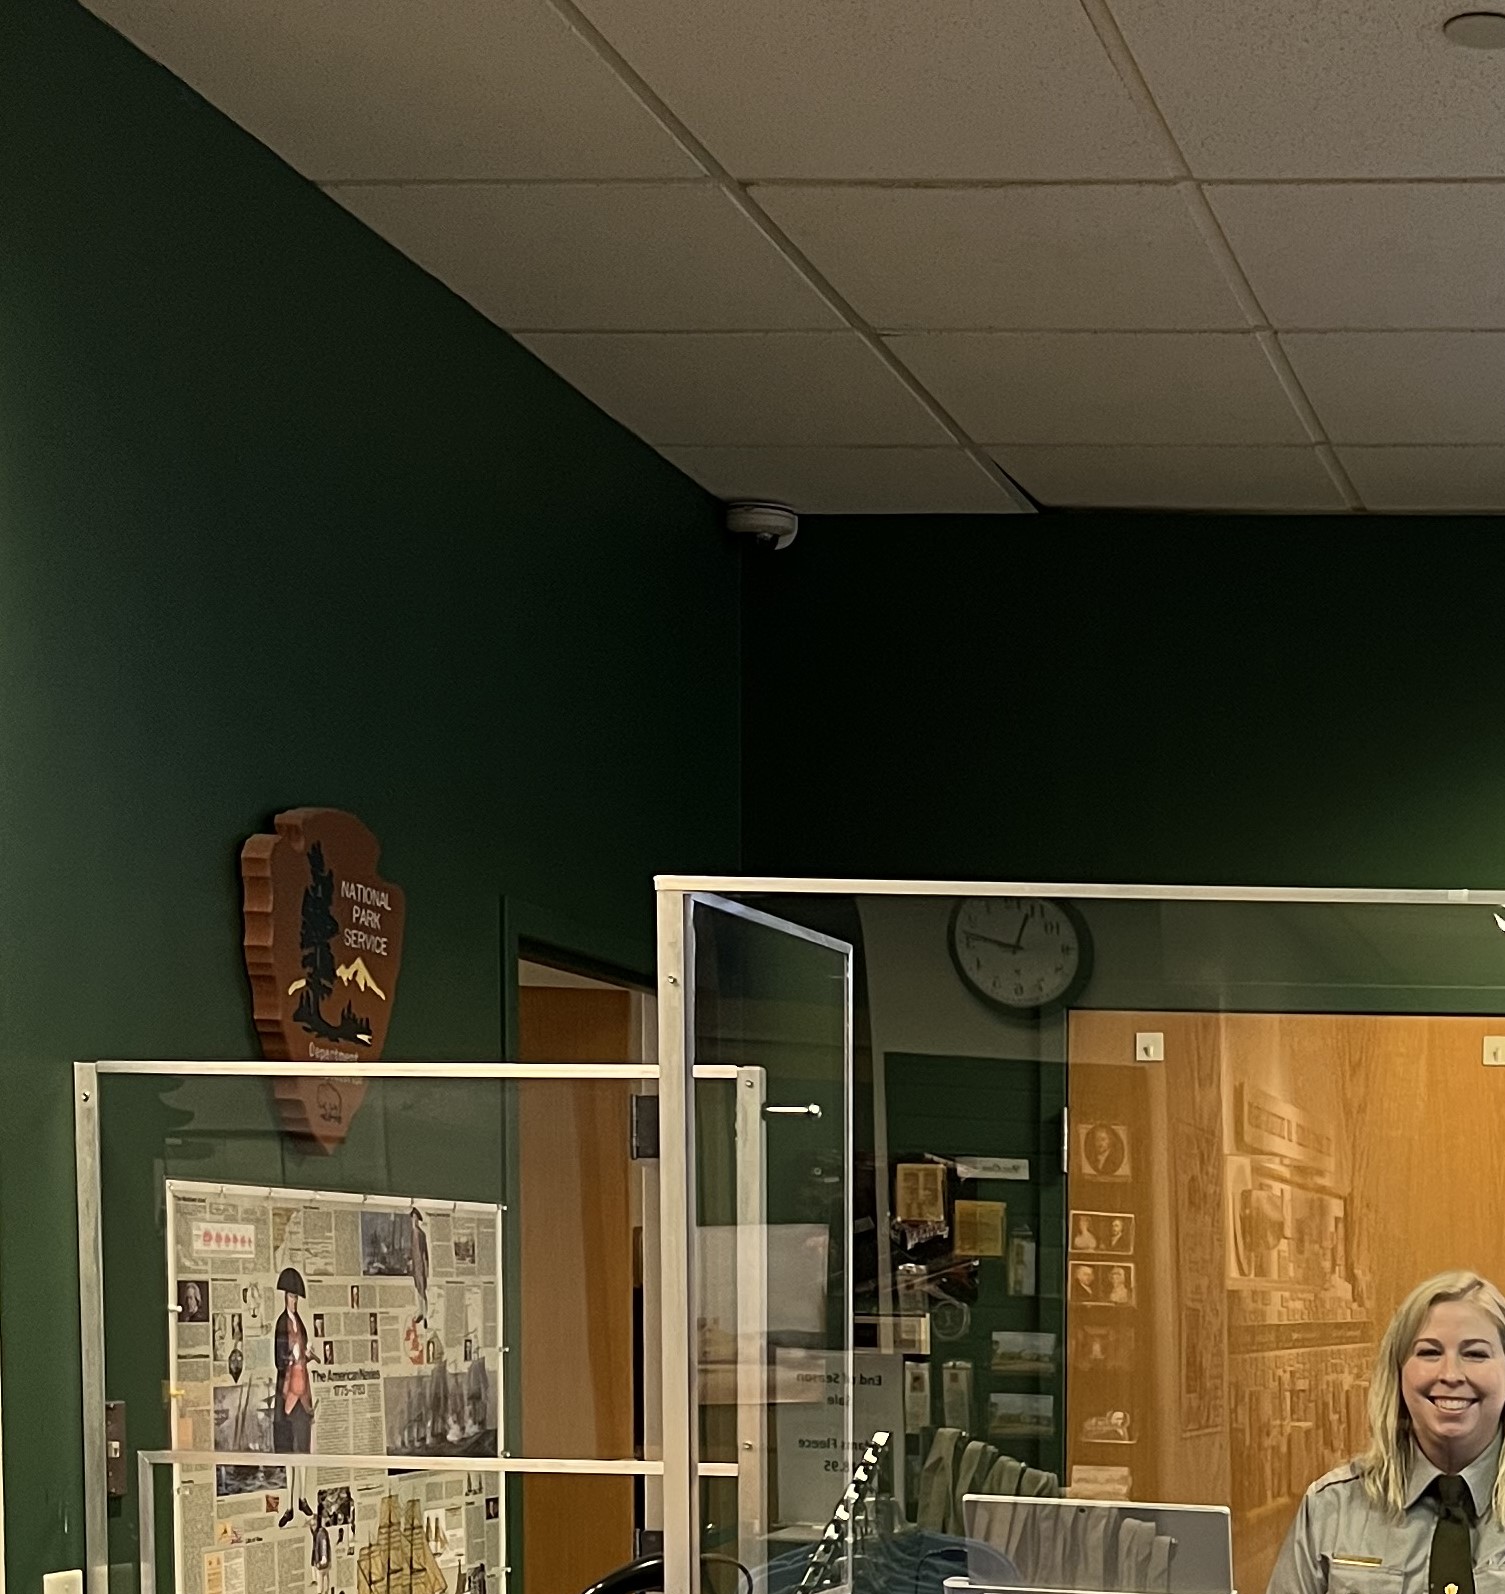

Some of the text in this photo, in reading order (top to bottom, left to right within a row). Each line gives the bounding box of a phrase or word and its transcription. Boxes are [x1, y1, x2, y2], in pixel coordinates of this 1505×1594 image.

[340, 880, 392, 911] NATIONAL
[352, 905, 382, 930] PARK
[343, 928, 388, 957] SERVICE
[308, 1041, 360, 1062] Department
[311, 1370, 327, 1383] The
